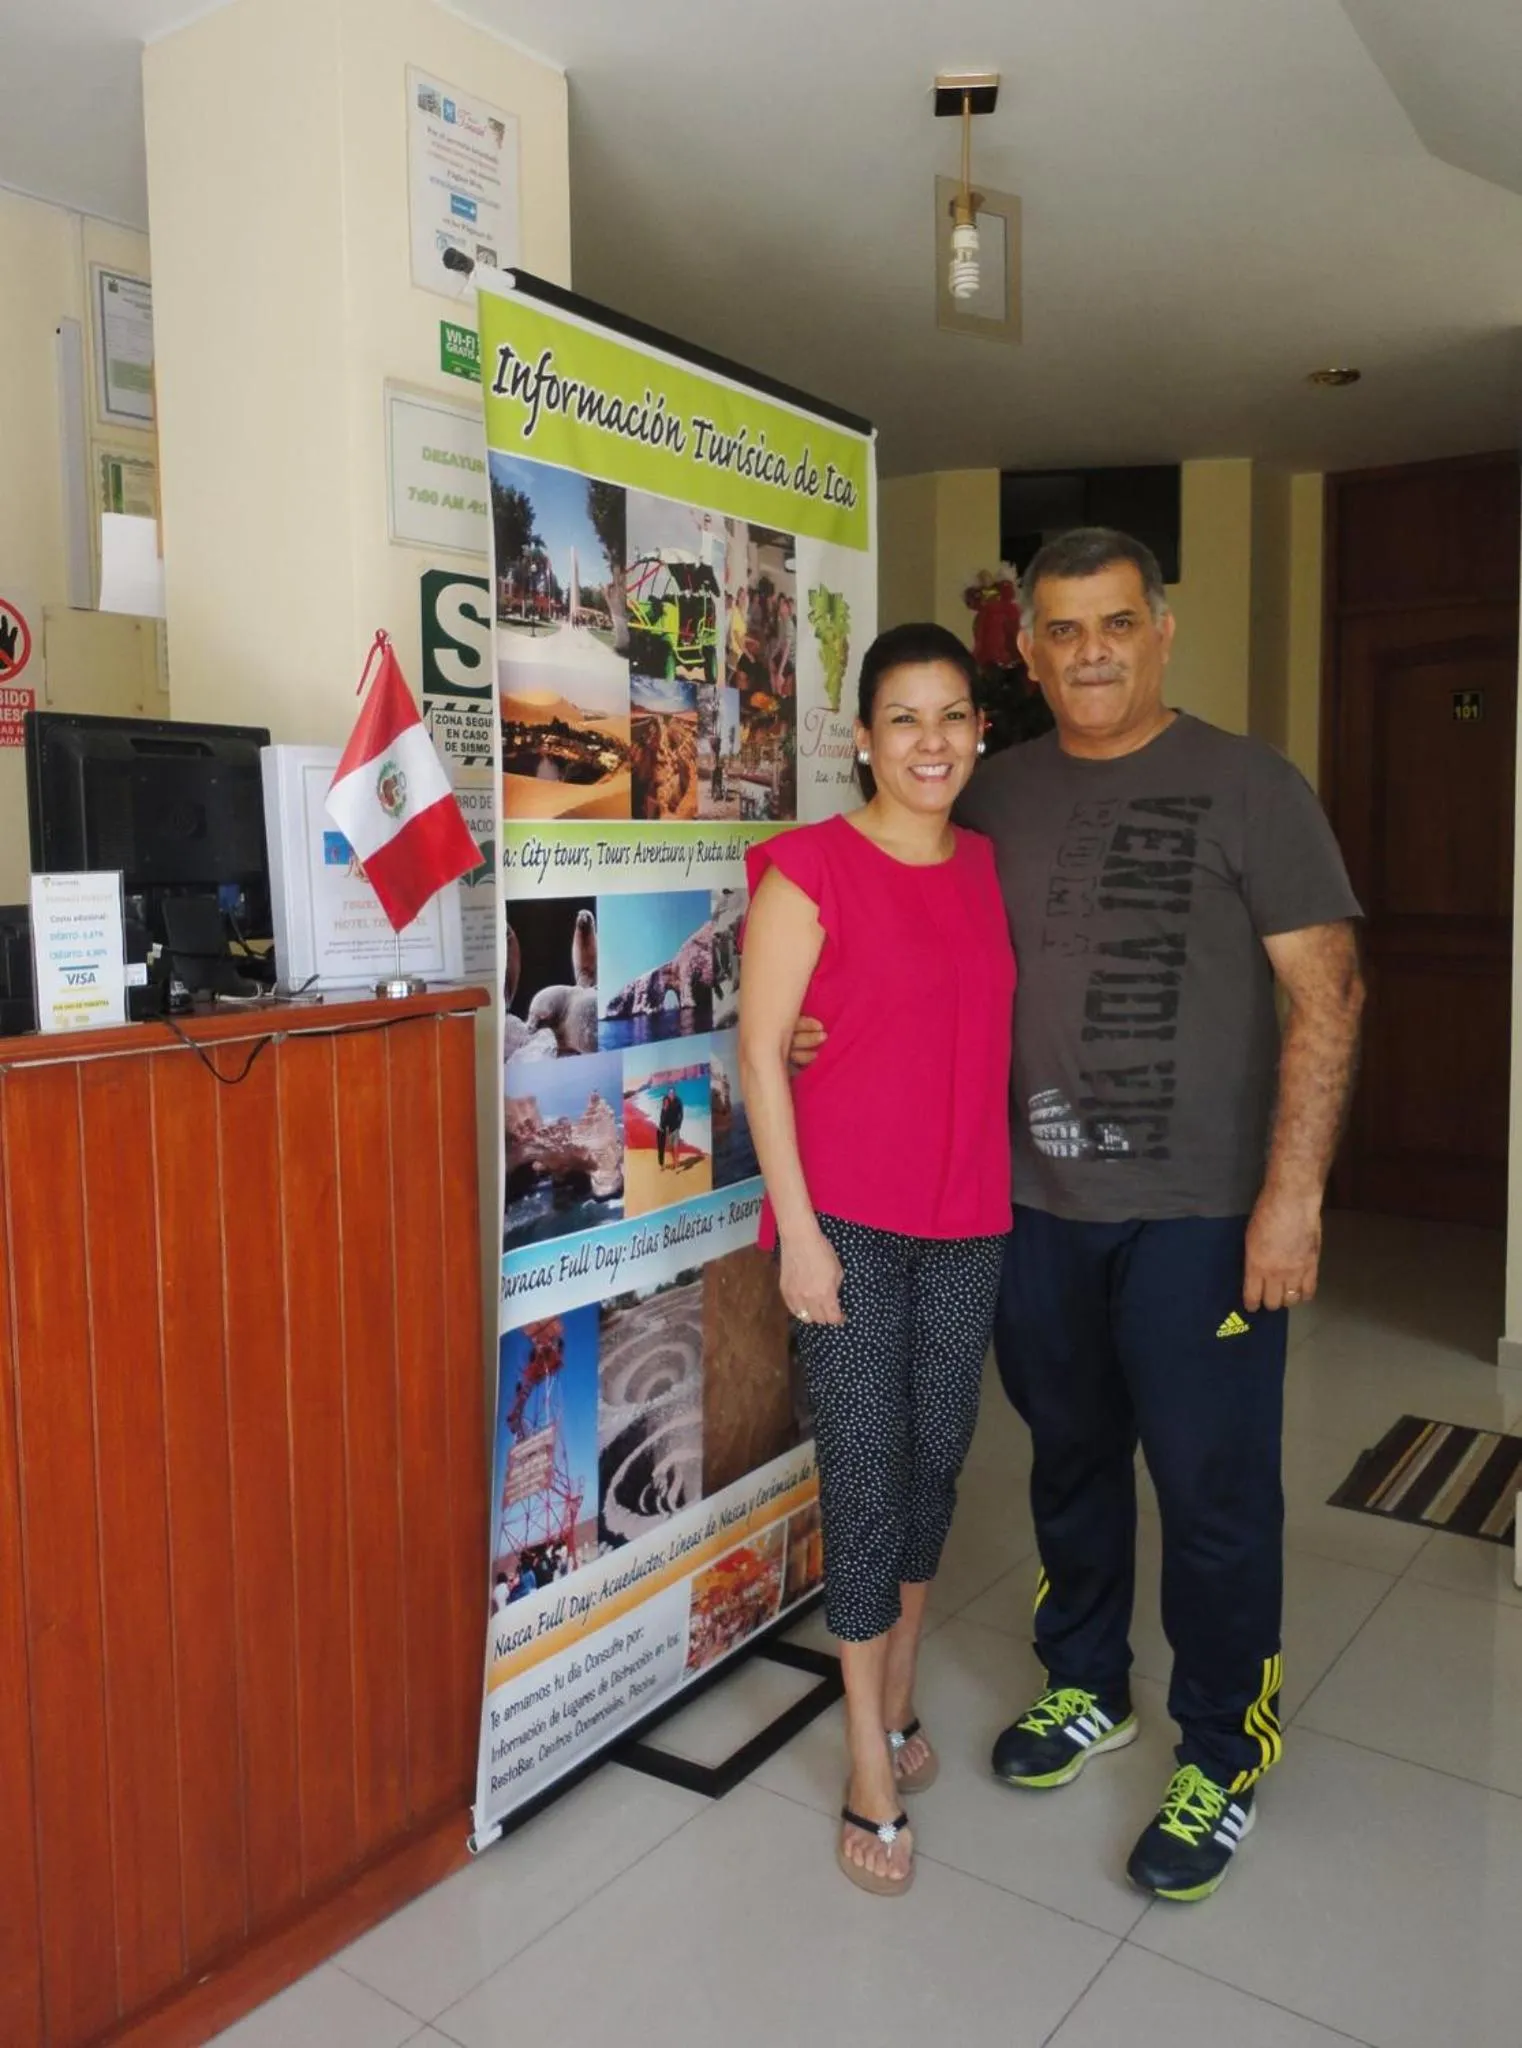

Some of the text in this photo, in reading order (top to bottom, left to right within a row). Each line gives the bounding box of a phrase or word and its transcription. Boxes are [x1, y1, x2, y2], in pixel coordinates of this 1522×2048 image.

[491, 346, 857, 509] Información Turísica de Ica
[433, 583, 493, 690] S
[435, 713, 462, 726] ZONA
[444, 740, 491, 754] DE SISMO
[446, 728, 489, 741] EN CASO
[479, 795, 493, 809] DE
[520, 839, 550, 884] City
[553, 842, 592, 872] tours,
[597, 841, 632, 866] Tours
[685, 846, 694, 877] y
[696, 839, 722, 863] Ruta
[722, 836, 742, 862] del
[1098, 795, 1213, 914] VENI
[66, 972, 96, 985] VISA
[1081, 932, 1187, 1042] VIDI
[559, 1244, 590, 1282] Full
[595, 1244, 628, 1283] Day:
[630, 1227, 660, 1261] Islas
[662, 1212, 714, 1248] Ballestas
[716, 1212, 725, 1229] +
[493, 1627, 534, 1661] Nasca
[536, 1600, 566, 1637] Full
[568, 1590, 598, 1626] Day:
[703, 1514, 719, 1539] de
[719, 1502, 749, 1531] Nasca
[490, 1707, 502, 1732] Te
[503, 1683, 552, 1724] armamos
[552, 1672, 566, 1693] tu
[583, 1636, 626, 1675] Consulte
[490, 1717, 547, 1765] Información
[548, 1708, 561, 1728] de
[562, 1688, 597, 1720] Lugares
[597, 1678, 610, 1697] de
[537, 1727, 574, 1763] Centros
